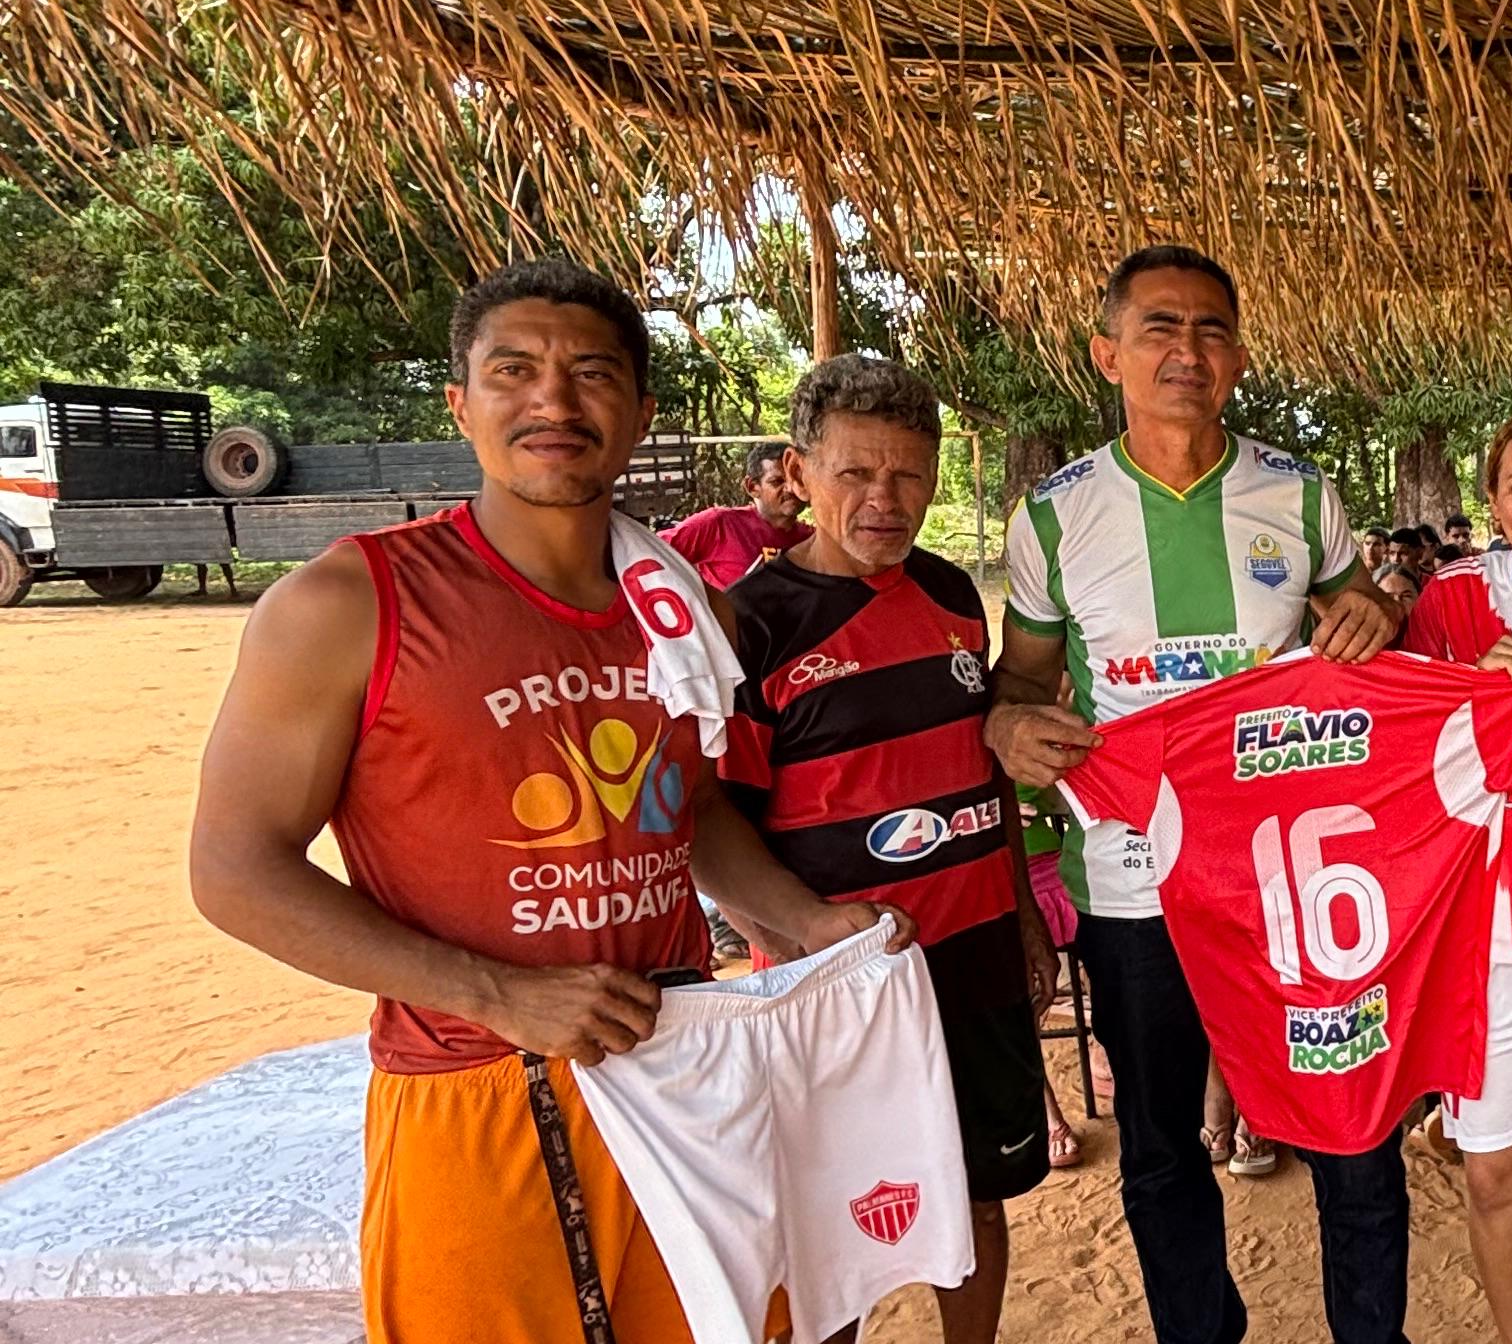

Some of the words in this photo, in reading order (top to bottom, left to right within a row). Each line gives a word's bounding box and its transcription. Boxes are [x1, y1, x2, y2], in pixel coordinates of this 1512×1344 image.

[1253, 446, 1317, 474] Keke
[622, 558, 694, 640] 6
[1154, 639, 1222, 652] GOVERNO
[1229, 637, 1247, 648] DO
[1237, 710, 1369, 754] FLÁVIO
[1238, 708, 1292, 726] PREFEITO
[1237, 738, 1367, 778] SOARES
[1123, 855, 1142, 869] do
[1251, 803, 1390, 986] 16
[1288, 987, 1384, 1022] VICE-PREFEITO
[1289, 1011, 1362, 1047] BOAZ
[1292, 1026, 1387, 1070] ROCHA
